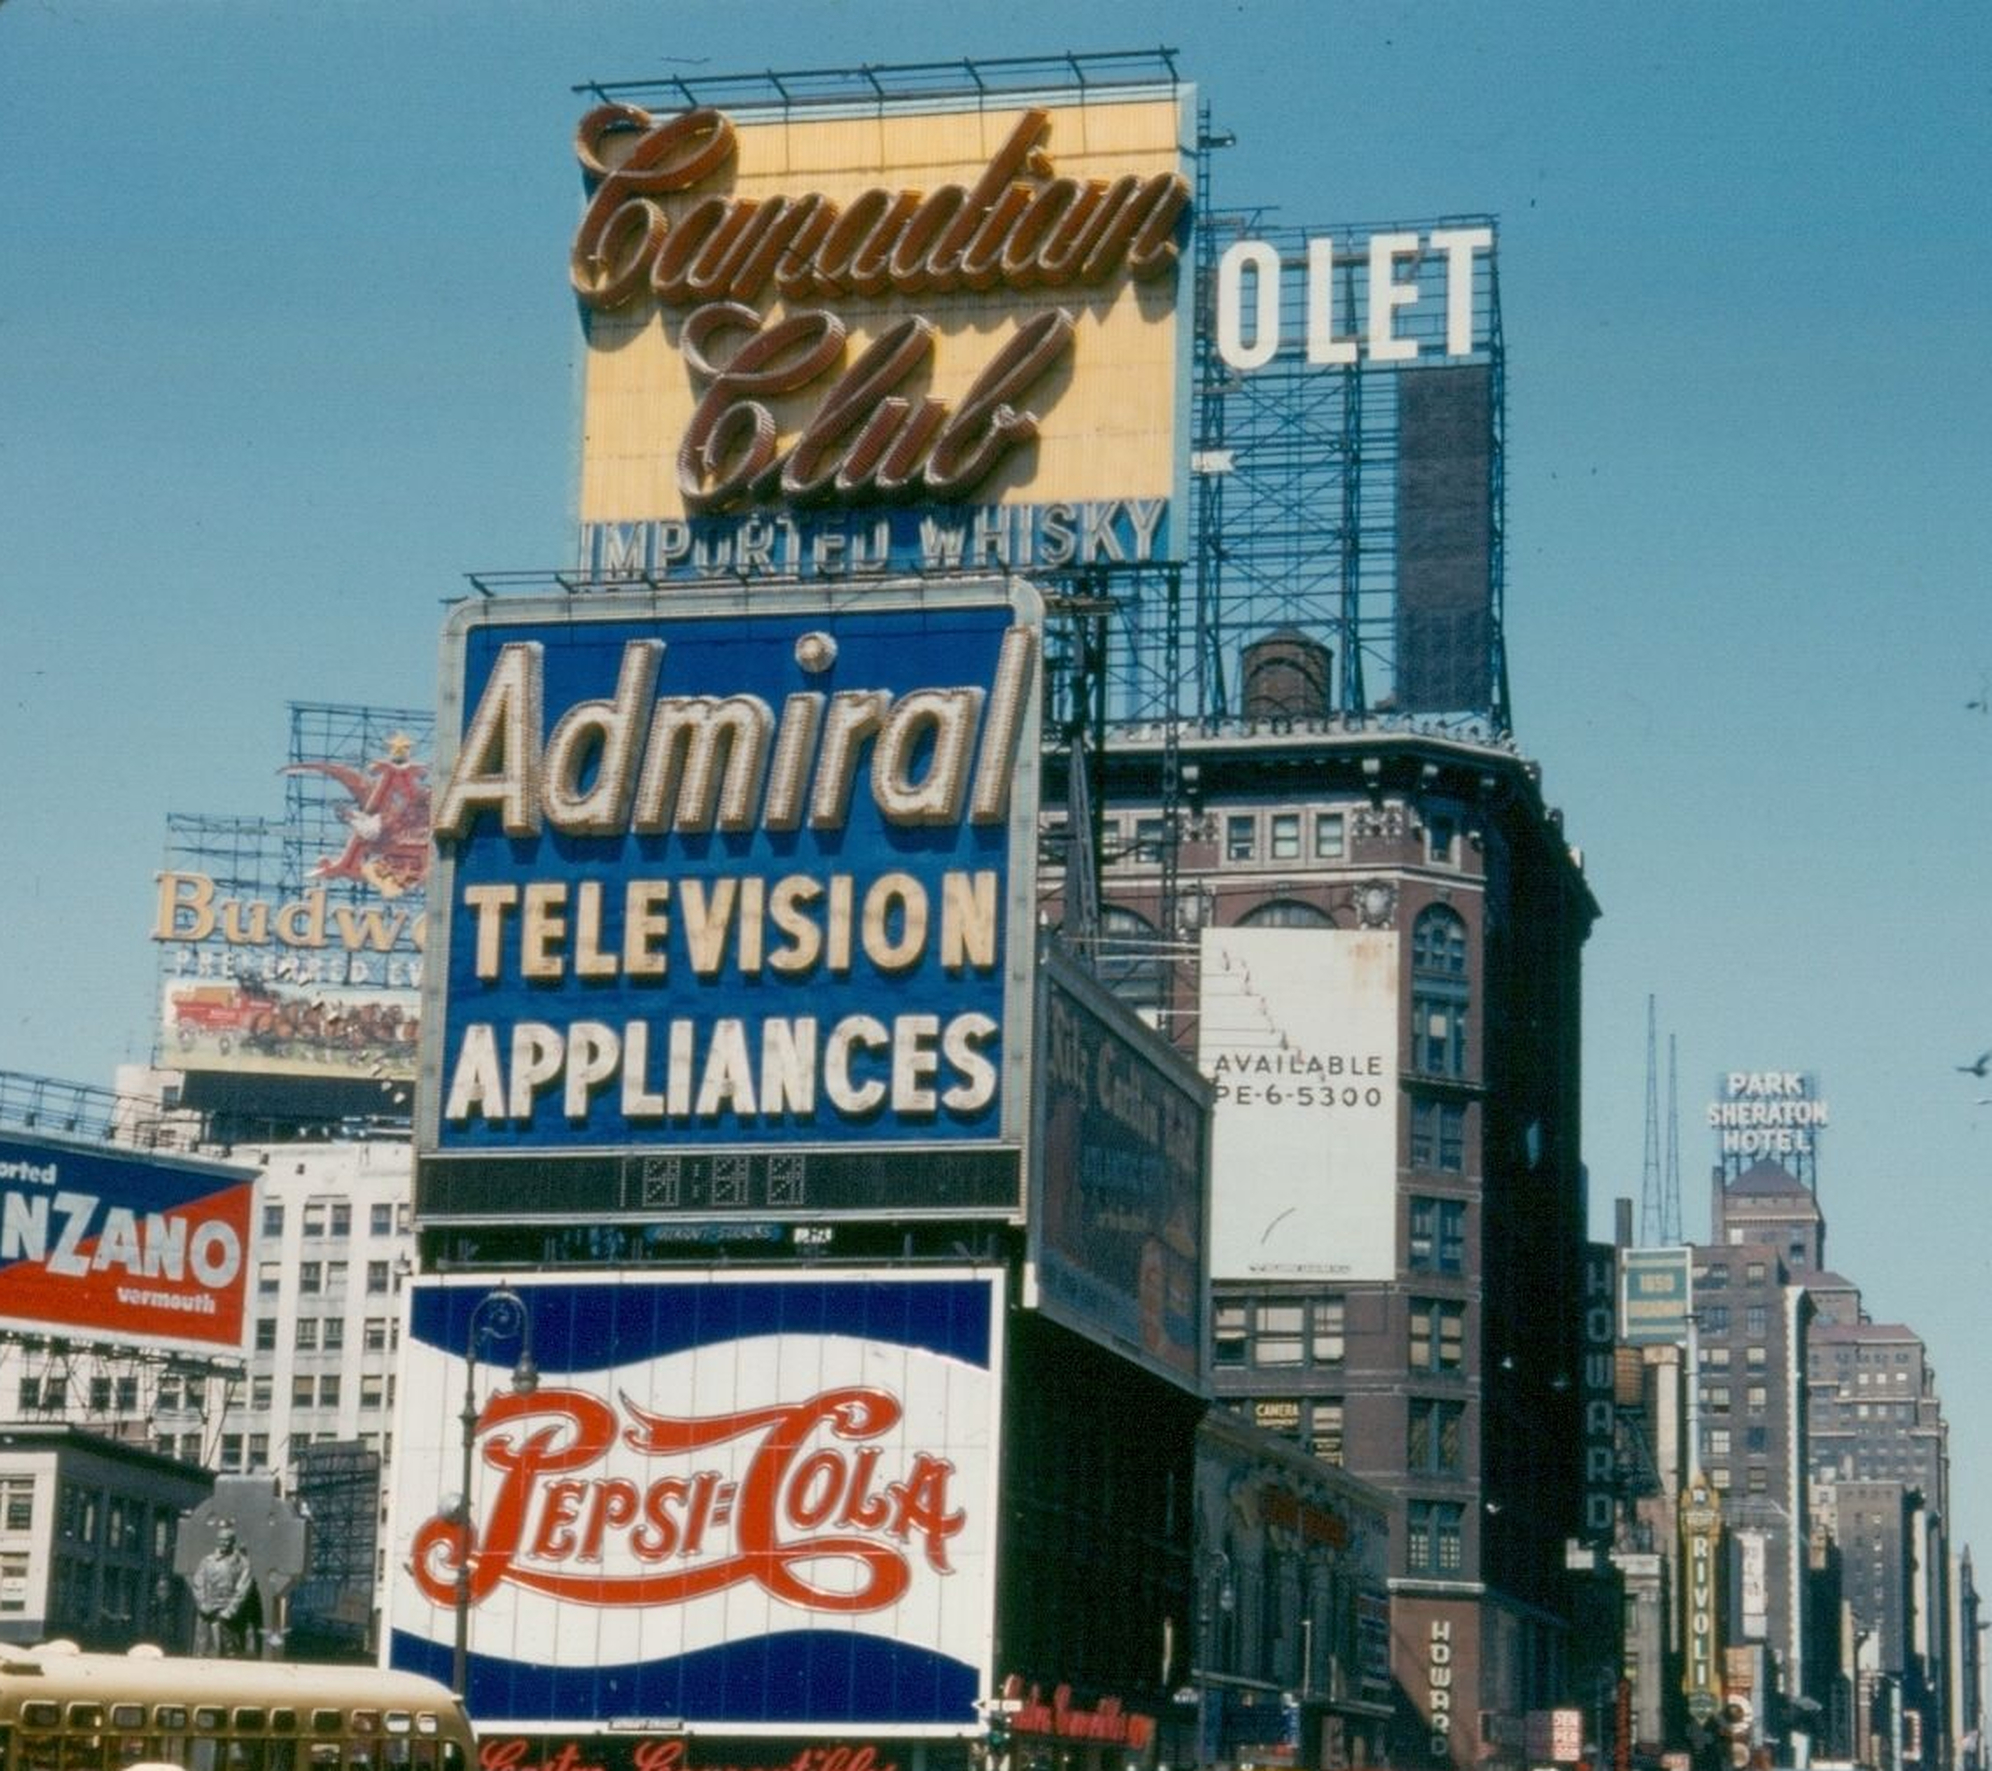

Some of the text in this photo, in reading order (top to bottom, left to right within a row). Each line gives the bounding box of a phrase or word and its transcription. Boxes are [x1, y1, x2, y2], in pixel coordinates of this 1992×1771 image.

[570, 104, 1189, 308] Canadian
[676, 302, 1074, 510] Club
[919, 498, 1167, 568] WHISKY
[432, 624, 1034, 840] Admiral
[464, 870, 997, 978] TELEVISION
[445, 1012, 999, 1122] APPLIANCES
[1215, 1054, 1383, 1076] AVAILABLE
[1215, 1084, 1382, 1107] PE-6-5300
[1708, 1102, 1829, 1128] SHERATON
[1727, 1073, 1803, 1097] PARK
[1723, 1129, 1813, 1153] HOTEL
[117, 1287, 216, 1314] vermouth
[1584, 1260, 1614, 1530] HOWARD
[1693, 1536, 1709, 1686] RIVOLI
[1429, 1620, 1450, 1756] HOWARD
